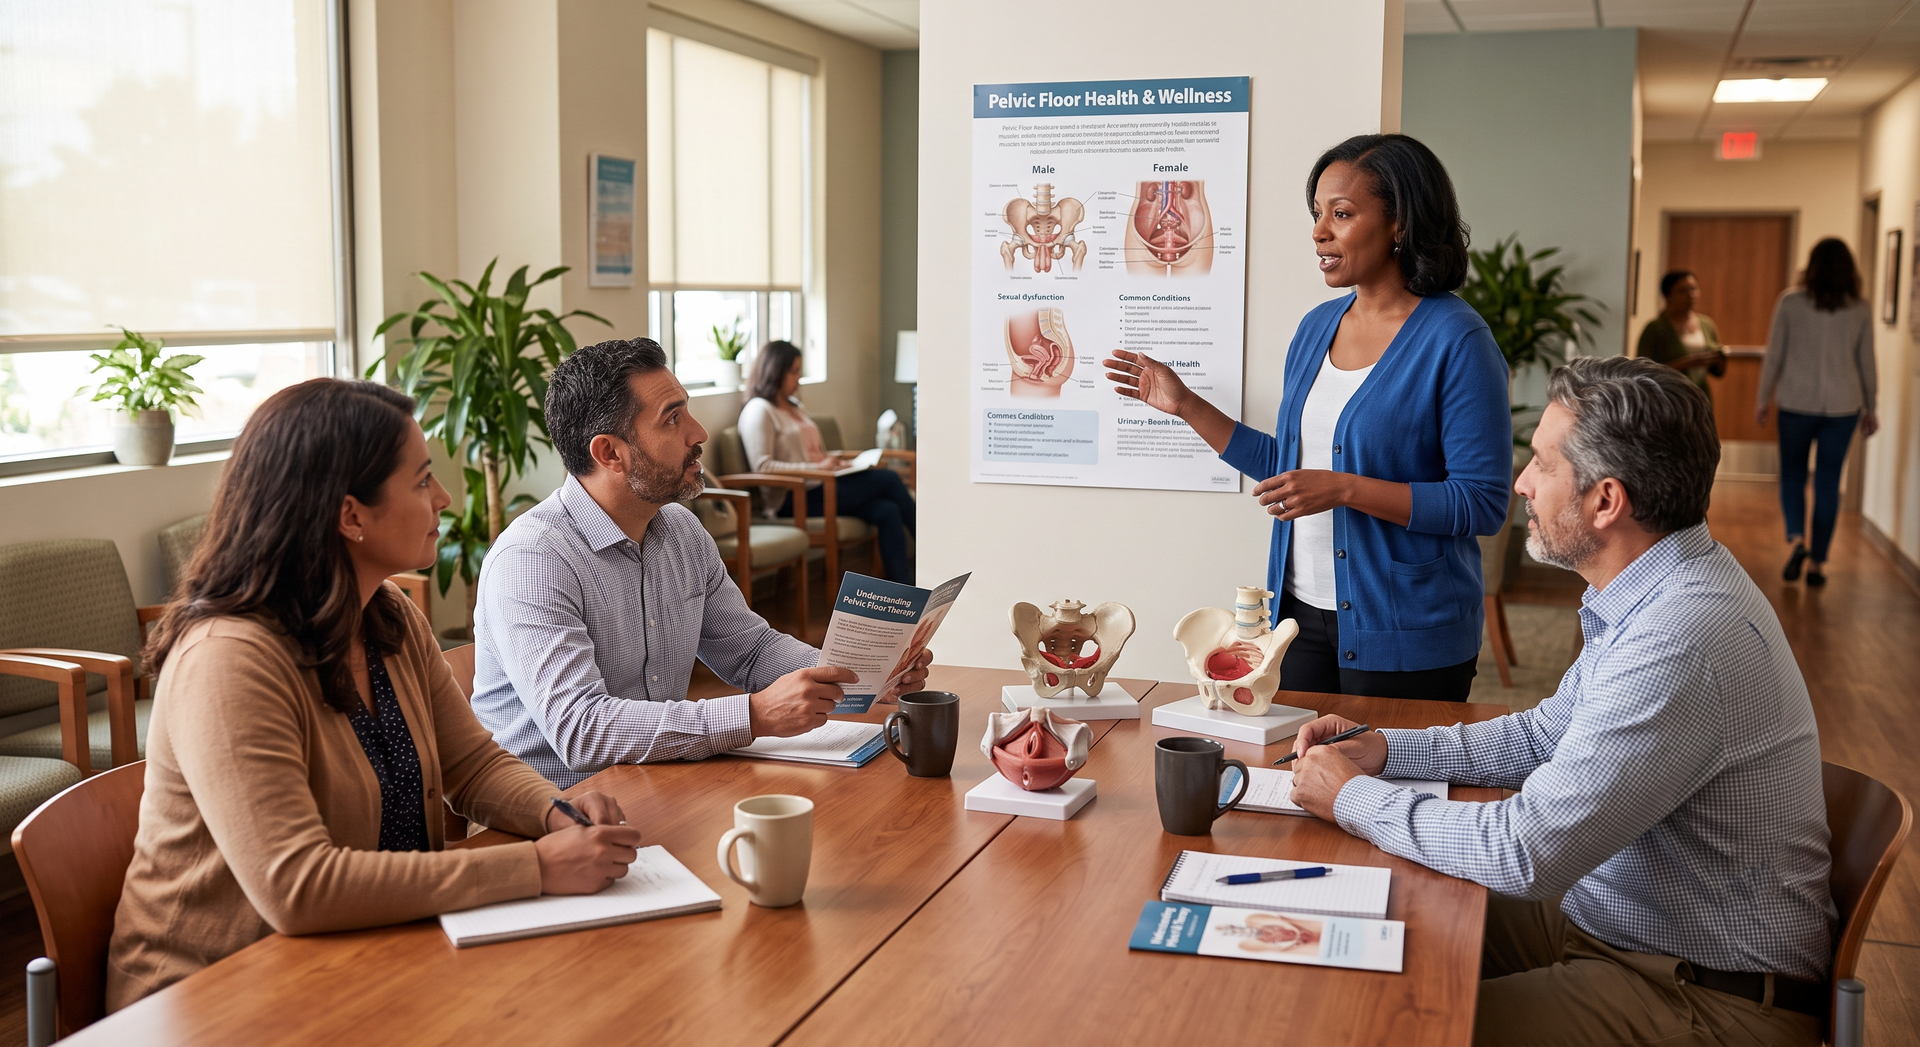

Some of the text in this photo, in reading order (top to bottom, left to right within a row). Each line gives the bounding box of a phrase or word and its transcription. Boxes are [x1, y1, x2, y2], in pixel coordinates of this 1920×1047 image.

[989, 87, 1232, 109] Pelvic Floor Health & Wellness
[1032, 165, 1056, 174] Male
[1153, 163, 1189, 172] Female
[1022, 293, 1065, 301] dysfunction
[856, 588, 912, 608] Understanding
[843, 595, 916, 618] Pelvic Floor Therapy
